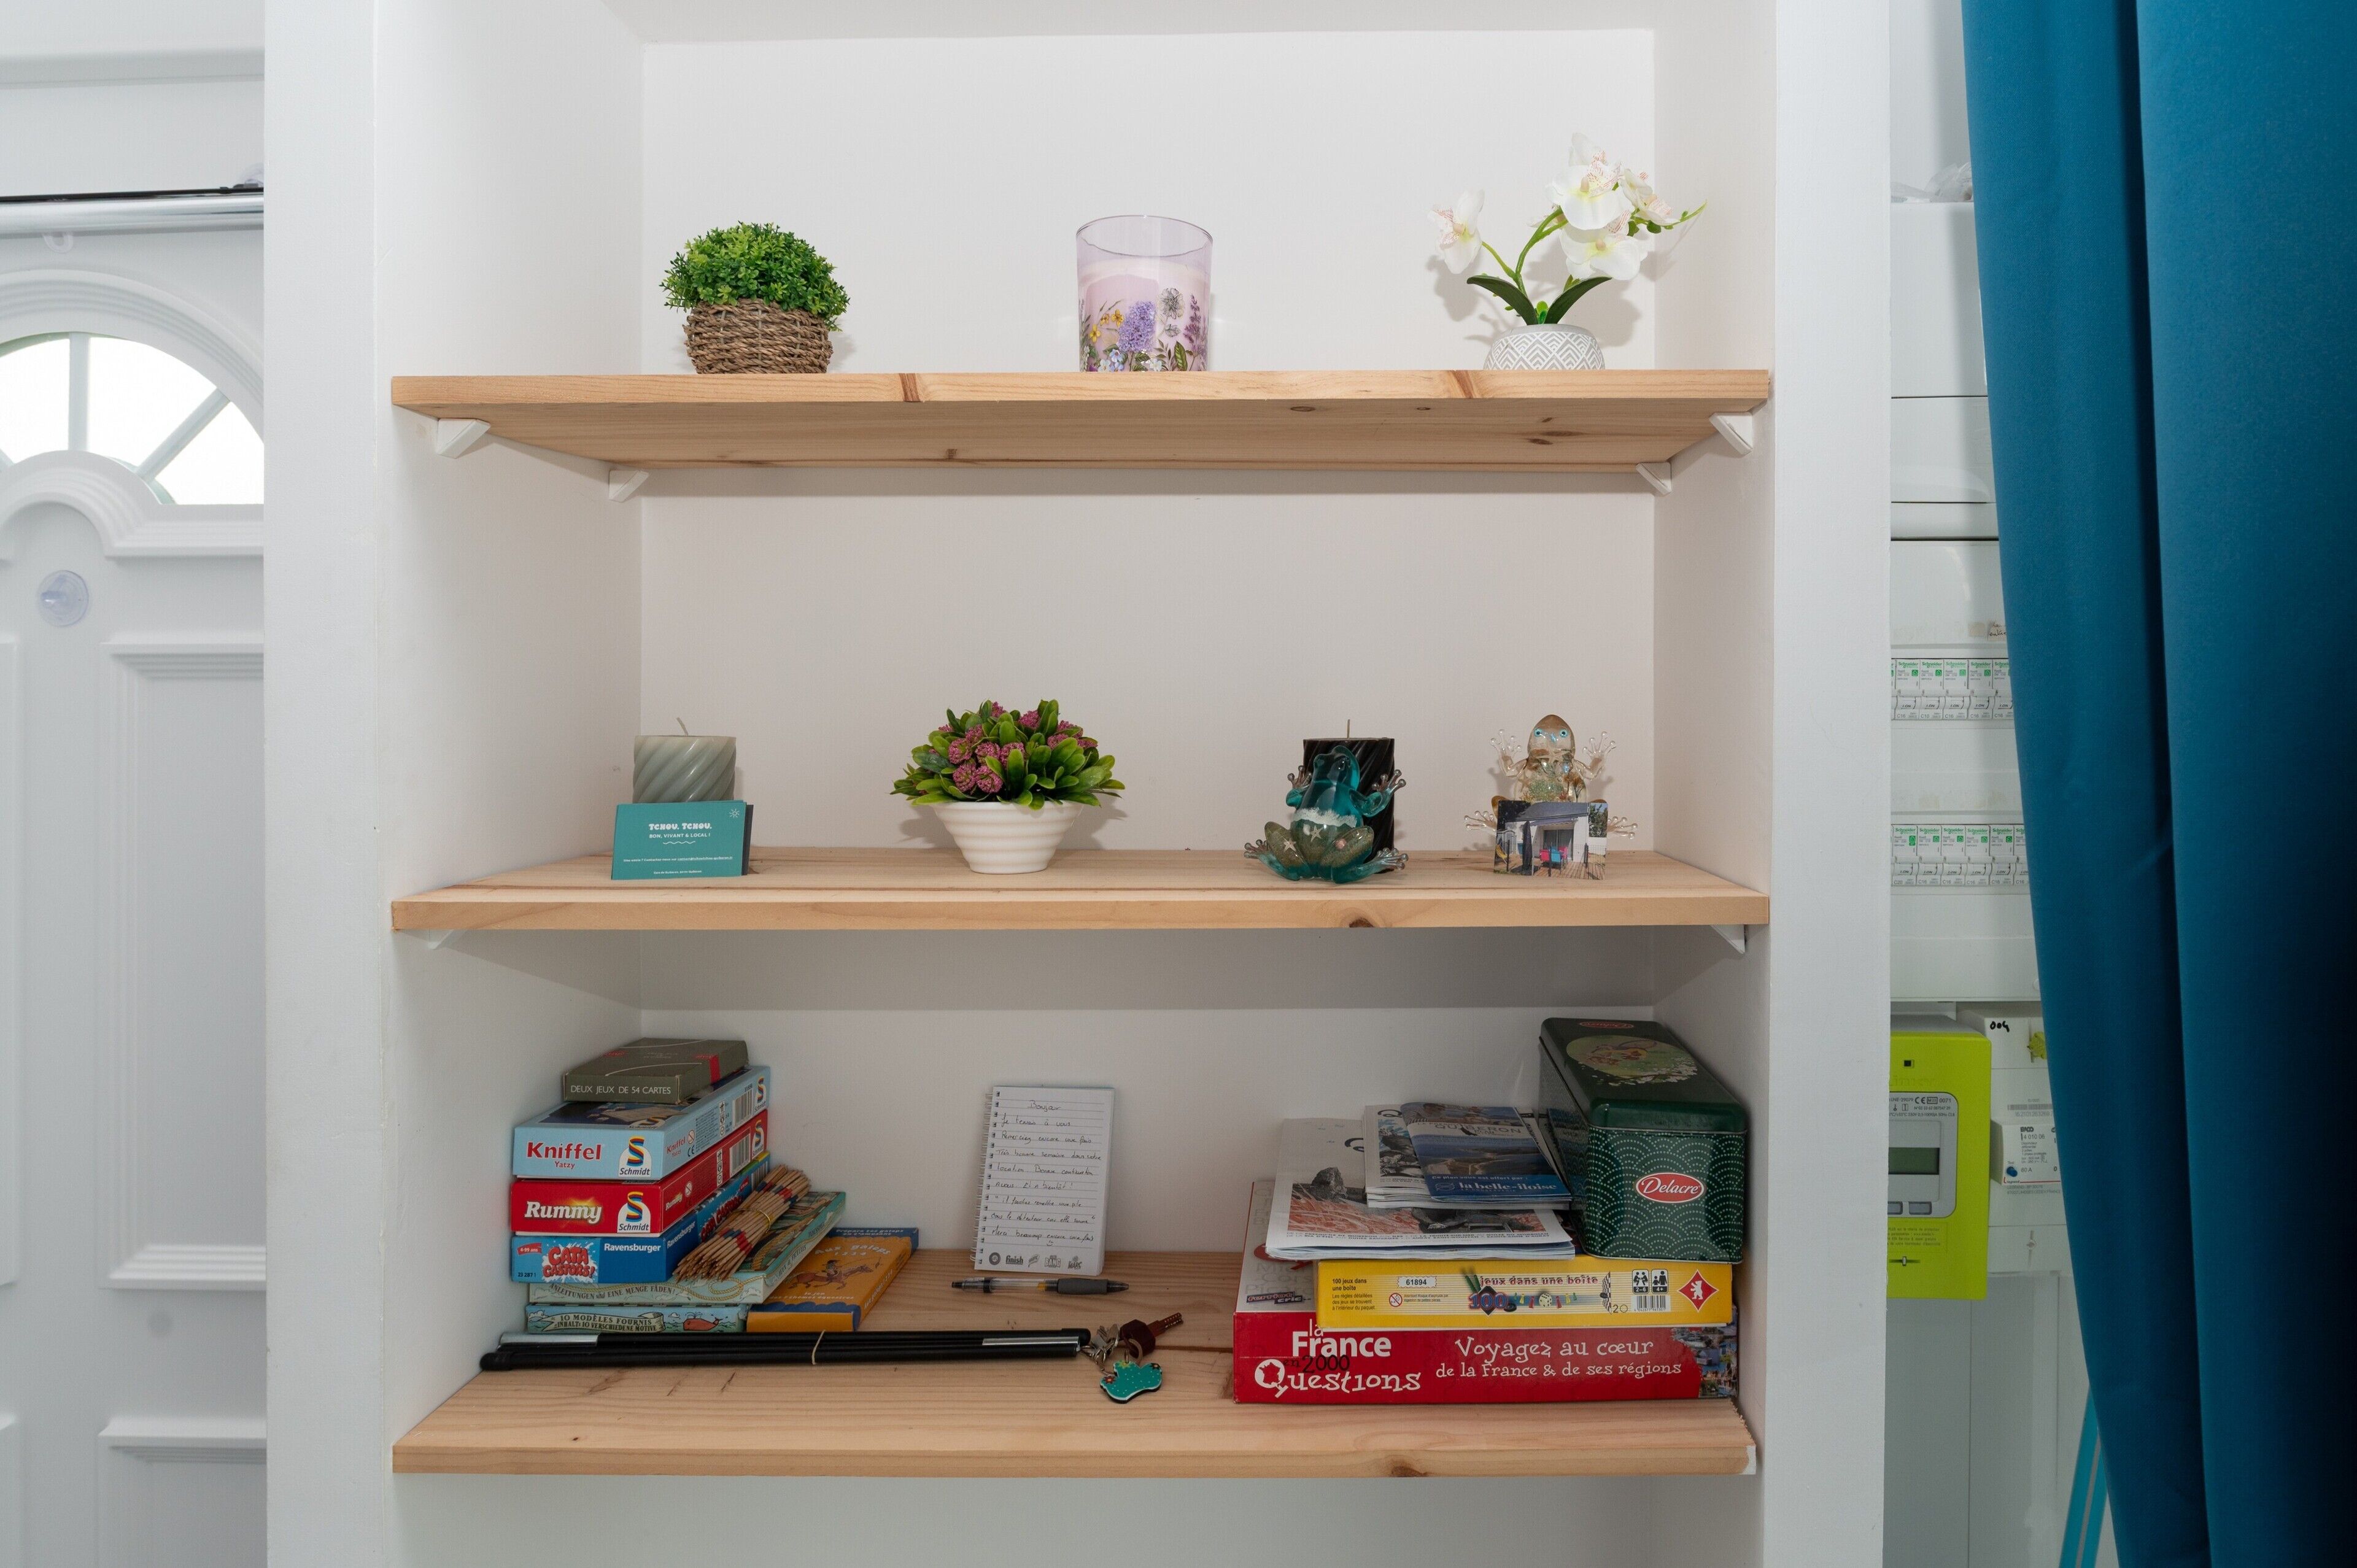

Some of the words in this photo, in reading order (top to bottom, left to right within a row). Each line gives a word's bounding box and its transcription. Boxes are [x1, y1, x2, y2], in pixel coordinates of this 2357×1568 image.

[571, 1085, 593, 1094] DEUX
[595, 1085, 614, 1094] JEUX
[631, 1086, 640, 1094] 54
[1029, 1100, 1061, 1112] Bonjour
[1001, 1113, 1009, 1127] Je
[527, 1142, 602, 1160] Kniffel
[667, 1137, 686, 1154] Kniffel
[555, 1161, 575, 1170] Yatzy
[619, 1167, 651, 1176] Schmidt
[1641, 1176, 1700, 1195] Delacre
[525, 1201, 603, 1224] Rummy
[667, 1221, 695, 1249] Ravensburger
[992, 1225, 1007, 1236] Merci
[604, 1243, 661, 1253] Ravensburger
[815, 1246, 842, 1255] Aux
[851, 1244, 891, 1256] galops
[548, 1246, 589, 1265] CATA
[1005, 1255, 1023, 1265] finish
[542, 1264, 596, 1278] CASTORS!
[1480, 1276, 1506, 1286] jeux
[1510, 1276, 1538, 1286] dans
[1568, 1275, 1599, 1285] boîte
[607, 1289, 624, 1299] EINE
[625, 1285, 647, 1295] MENGE
[1469, 1292, 1508, 1310] 100
[573, 1313, 614, 1324] MODÈLES
[590, 1323, 634, 1331] VERSCHIEDENE
[1309, 1319, 1323, 1337] la
[1293, 1331, 1391, 1358] France
[1455, 1336, 1552, 1364] Voyagez
[1560, 1342, 1589, 1356] au
[1596, 1340, 1654, 1356] cœur
[1283, 1358, 1299, 1368] en
[1302, 1354, 1350, 1374] 2000
[1436, 1363, 1454, 1378] de
[1460, 1362, 1476, 1377] la
[1482, 1362, 1538, 1377] France
[1543, 1364, 1556, 1377] &
[1562, 1361, 1581, 1377] de
[1586, 1364, 1613, 1376] ses
[1619, 1361, 1682, 1379] régions
[1255, 1358, 1421, 1399] Questions
